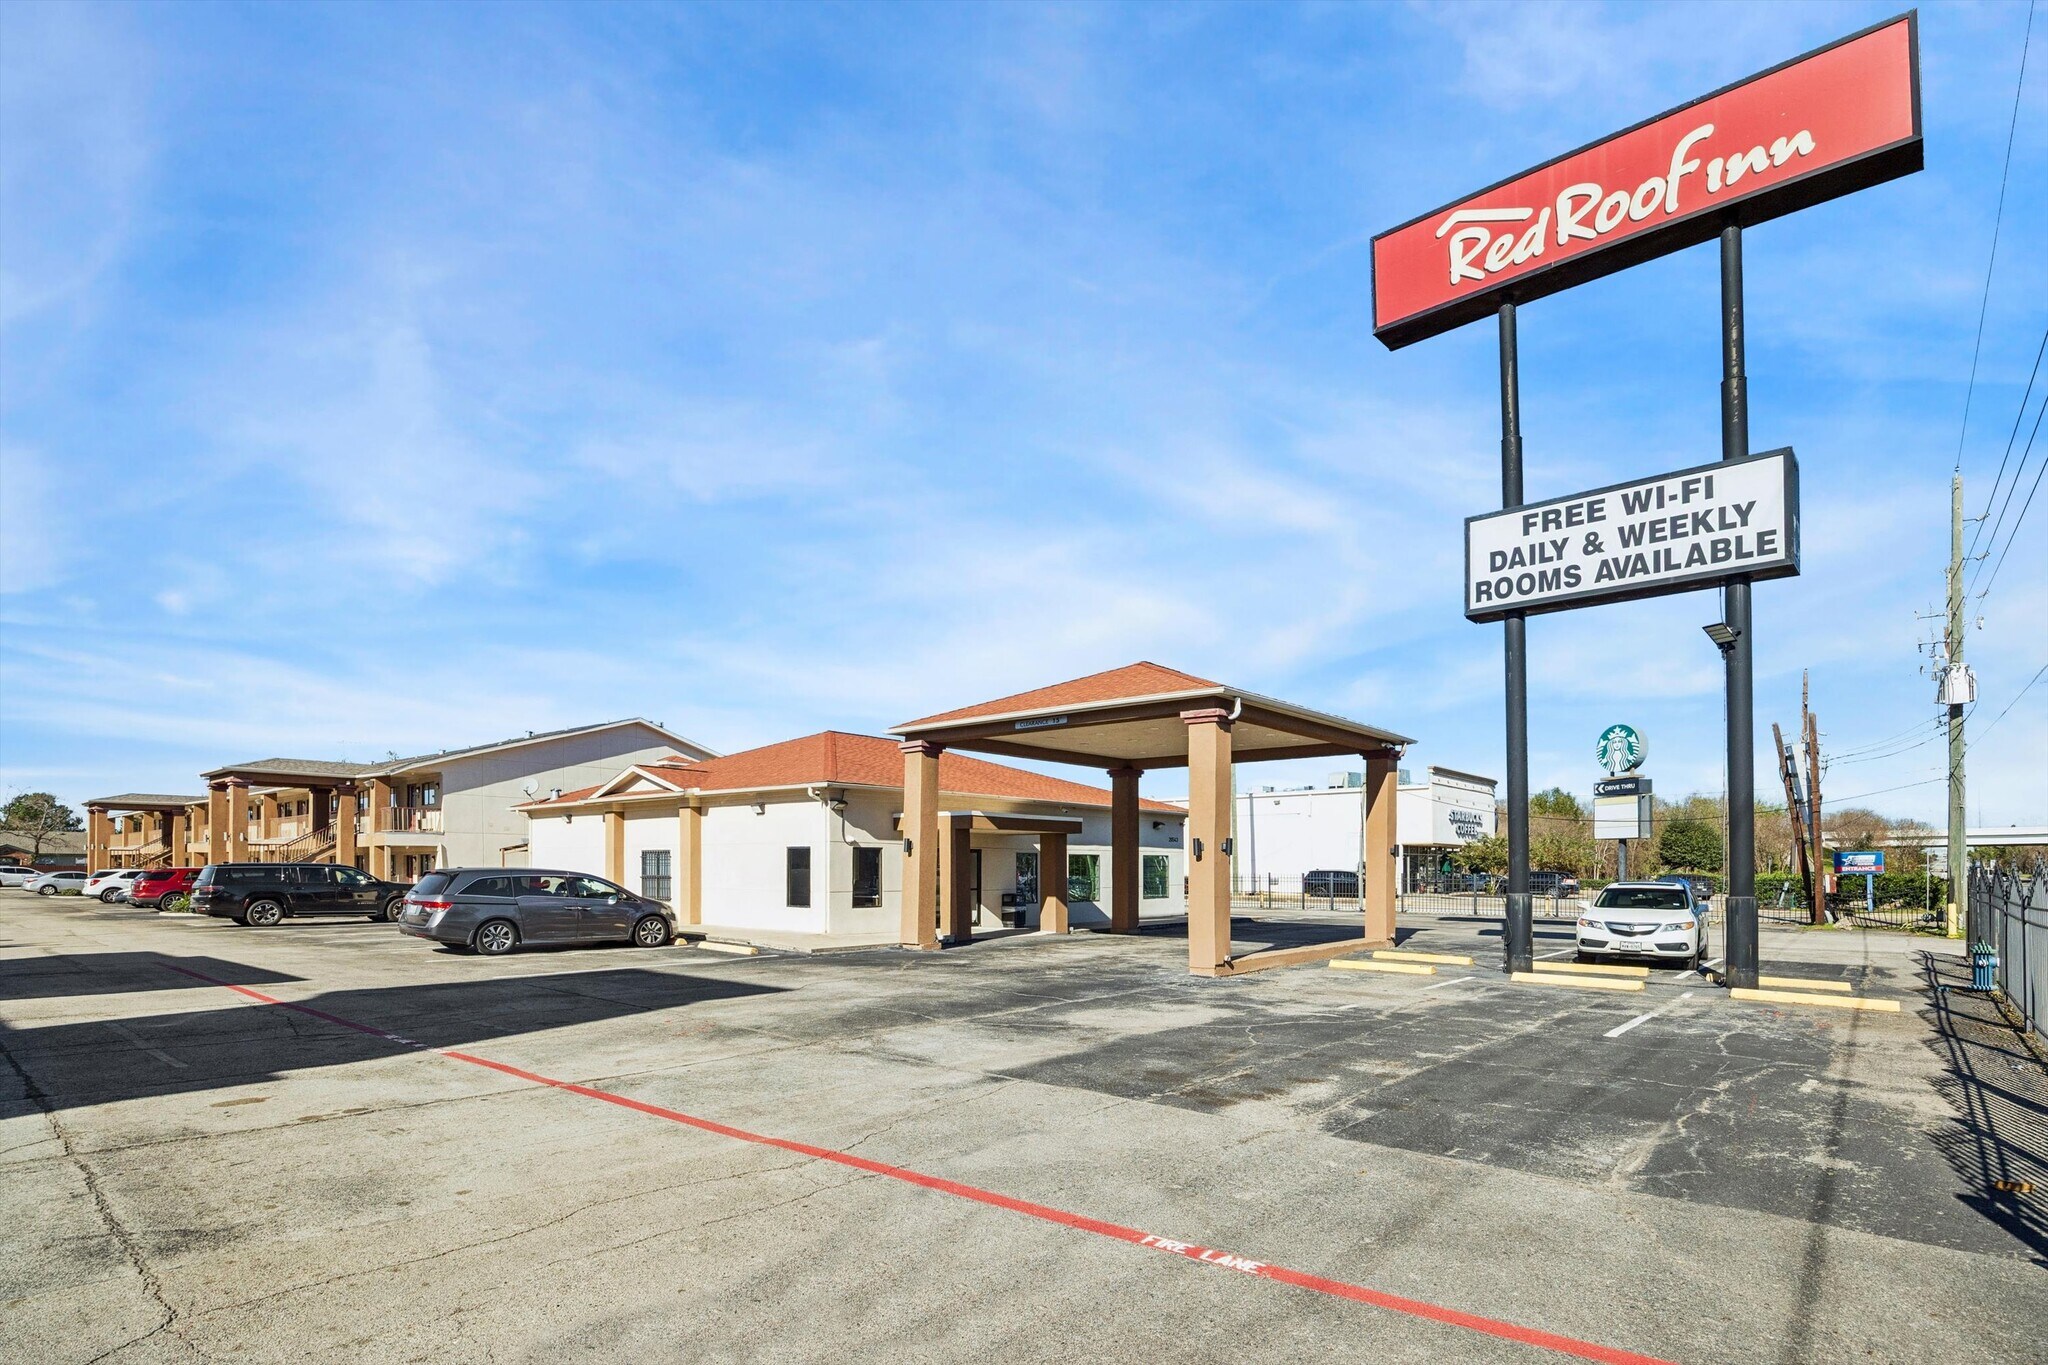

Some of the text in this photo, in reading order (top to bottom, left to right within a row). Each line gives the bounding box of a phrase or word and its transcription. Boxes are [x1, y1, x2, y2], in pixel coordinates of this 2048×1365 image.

[1448, 207, 1551, 285] Red
[1556, 123, 1714, 246] Roof
[1489, 500, 1757, 573] DAILY & WEEKLY
[1522, 475, 1715, 536] FREE WI-FI
[1475, 529, 1778, 603] ROOMS AVAILABLE
[1140, 1235, 1266, 1274] FIRE LANE
